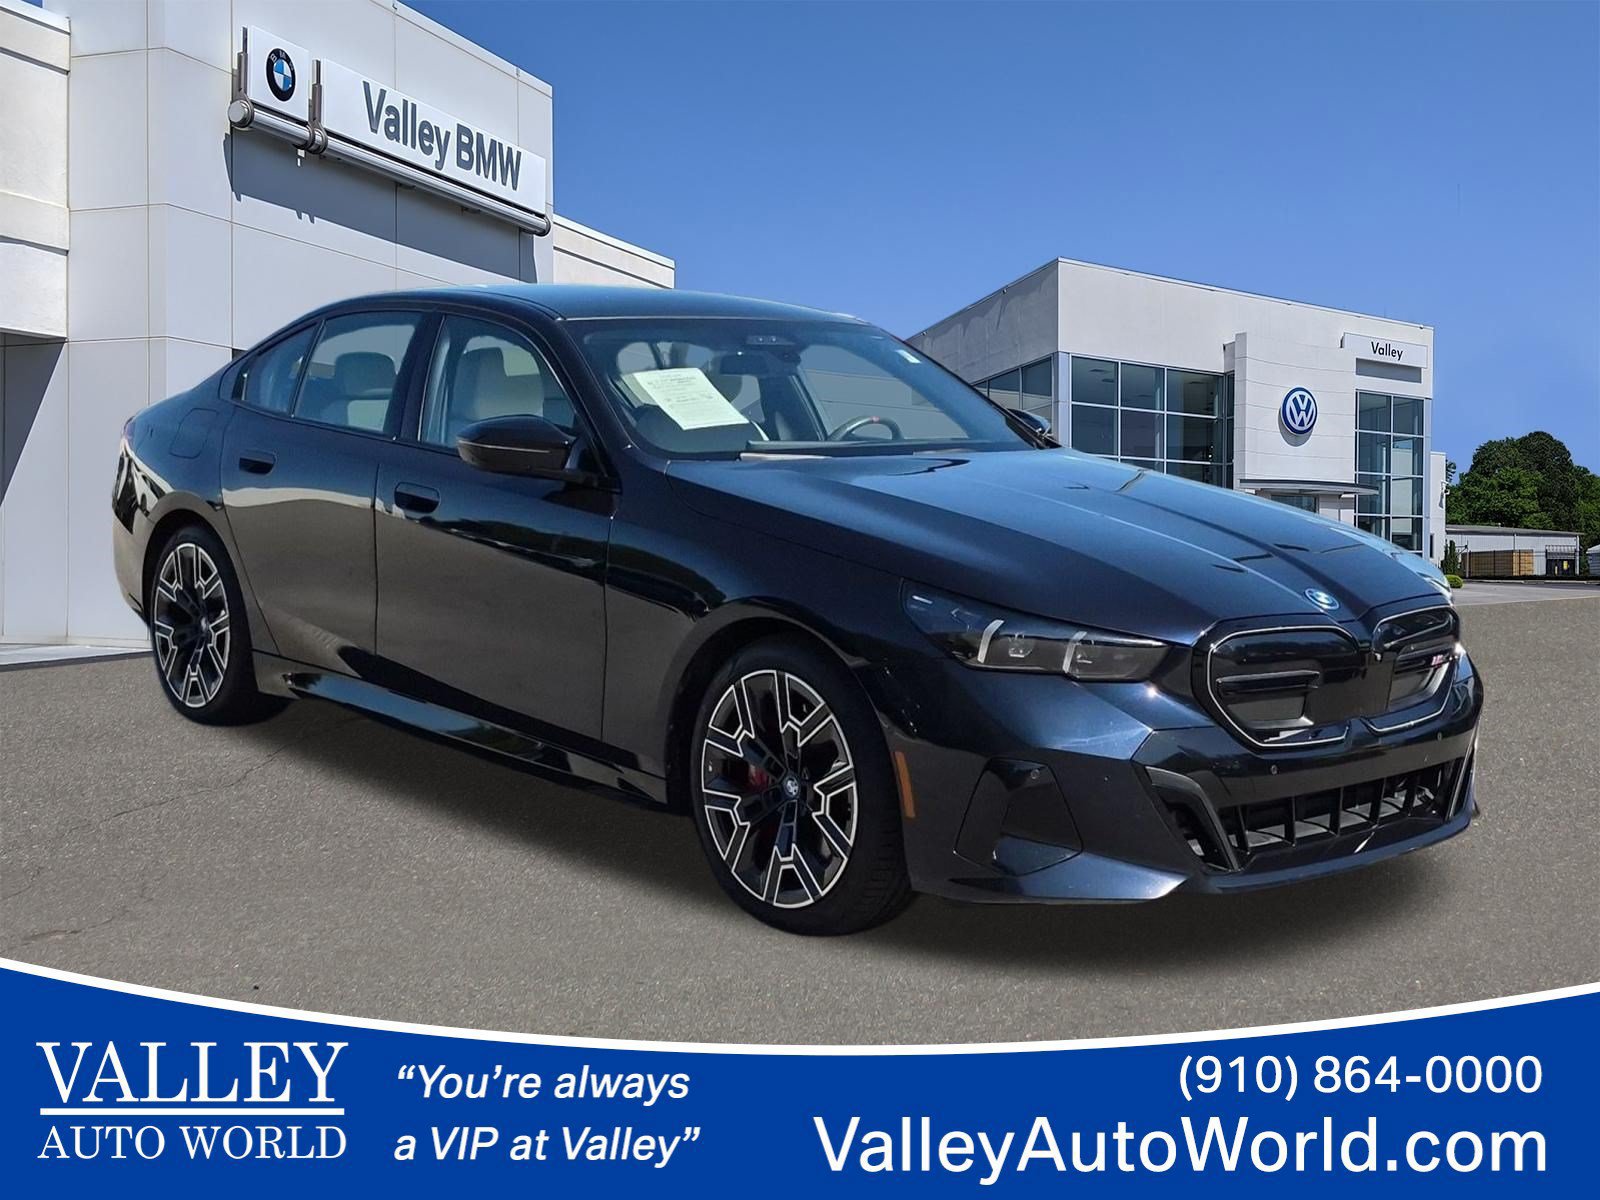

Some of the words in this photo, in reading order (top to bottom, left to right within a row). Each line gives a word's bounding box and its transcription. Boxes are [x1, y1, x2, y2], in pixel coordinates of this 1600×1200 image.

[363, 80, 451, 171] Valley
[457, 123, 522, 191] BMW
[1371, 341, 1403, 360] Valley
